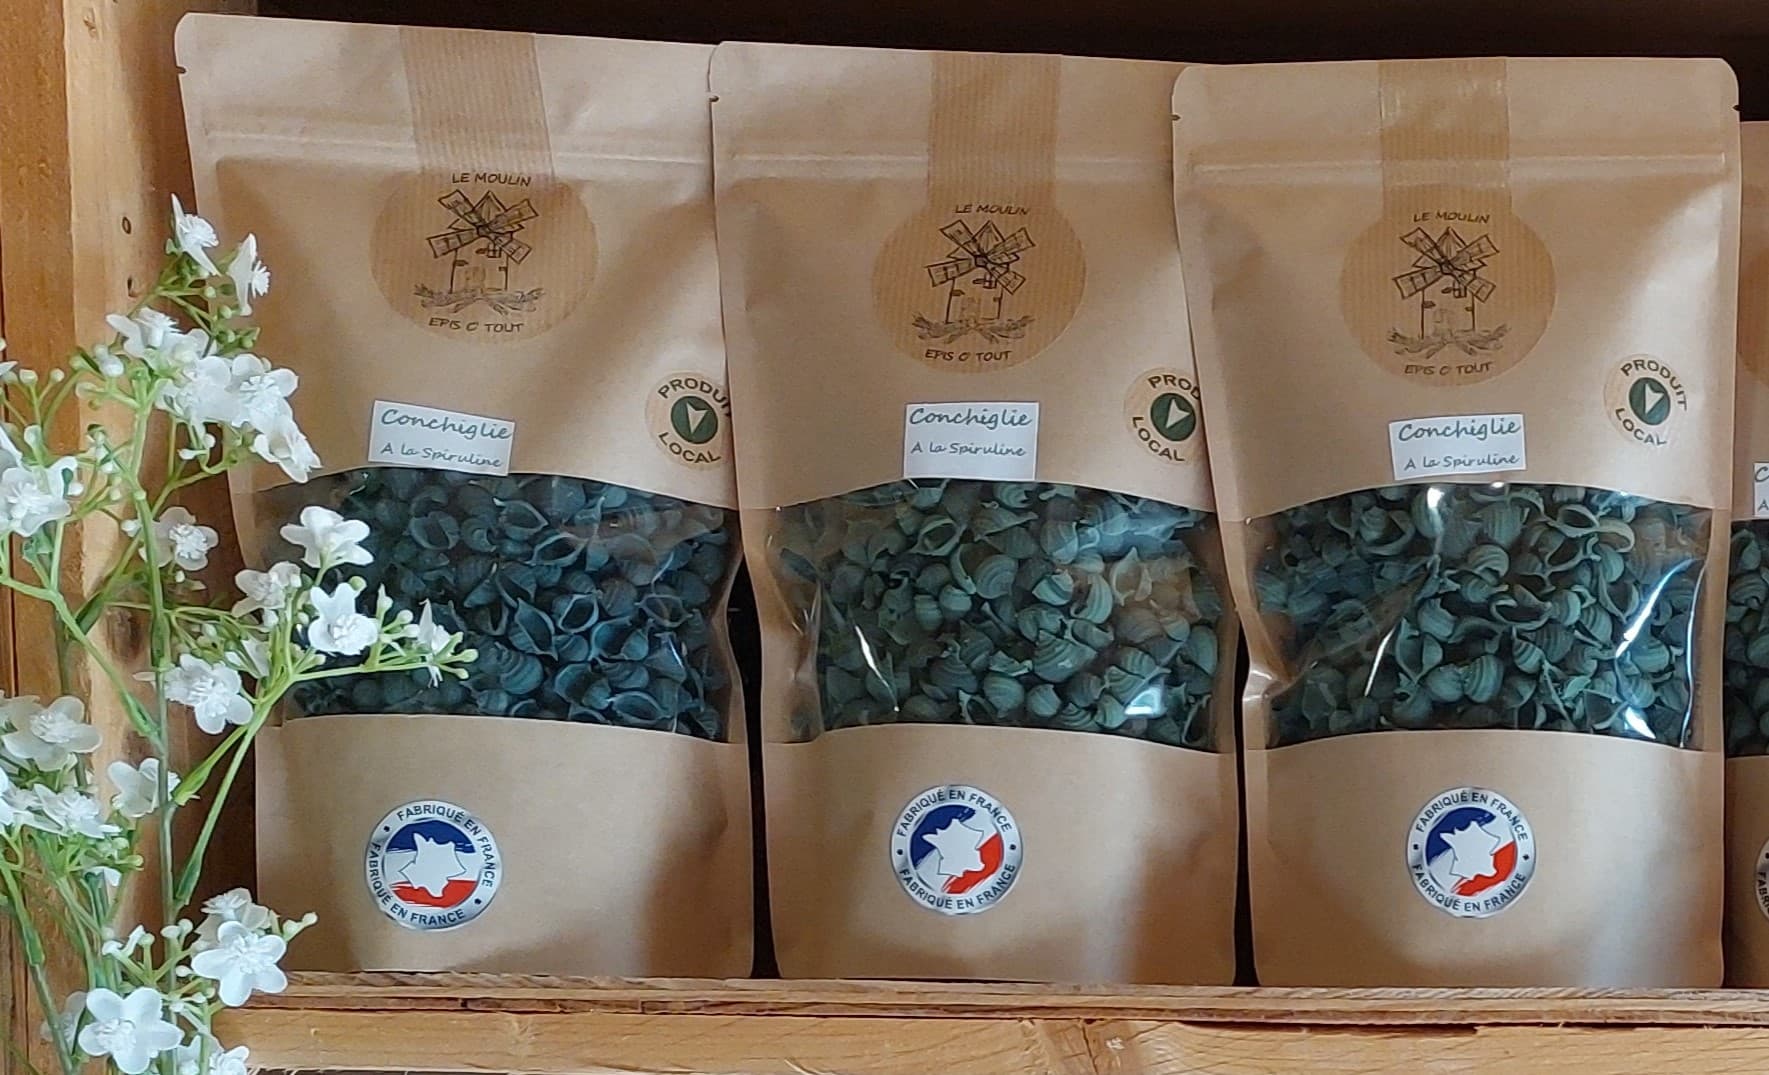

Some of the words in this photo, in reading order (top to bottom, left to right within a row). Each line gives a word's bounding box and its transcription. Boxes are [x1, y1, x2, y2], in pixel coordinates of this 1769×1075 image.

[452, 172, 470, 184] LE
[474, 173, 531, 187] MOULIN
[955, 204, 972, 214] LE
[976, 204, 1031, 215] MOULIN
[1413, 212, 1430, 222] LE
[1435, 211, 1490, 224] MOULIN
[428, 317, 461, 330] EPIS
[485, 322, 524, 333] TOUT
[925, 348, 954, 361] EPIS
[975, 350, 1012, 362] TOUT
[1404, 364, 1434, 375] EPIS
[1456, 361, 1492, 375] TOUT
[1620, 359, 1688, 411] PRODUIT
[381, 408, 512, 440] Conchiglie
[909, 407, 1033, 430] Conchiglie
[1398, 416, 1521, 441] Conchiglie
[1615, 407, 1668, 446] LOCAL
[380, 442, 393, 455] A
[658, 431, 722, 463] LOCAL
[910, 441, 923, 454] A
[1132, 416, 1186, 462] LOCAL
[1403, 458, 1417, 471] A
[896, 789, 946, 837] FABRIQUÉ
[949, 789, 966, 800] EN
[968, 793, 1013, 832] FRANCE
[1415, 790, 1468, 832] FABRIQUÉ
[1471, 792, 1489, 804] EN
[1490, 798, 1529, 841] FRANCE
[397, 804, 466, 823] FABRIQUÉ
[463, 818, 482, 836] EN
[476, 836, 496, 888] FRANCE
[368, 841, 393, 906] FABRIQUÉ
[390, 903, 408, 919] EN
[410, 908, 466, 926] FRANCE
[899, 868, 953, 909] FABRIQUÉ
[956, 899, 975, 909] EN
[976, 863, 1016, 904] FRANCE
[1411, 864, 1461, 911] FABRIQUÉ
[1464, 901, 1481, 912] EN
[1484, 873, 1527, 910] FRANCE
